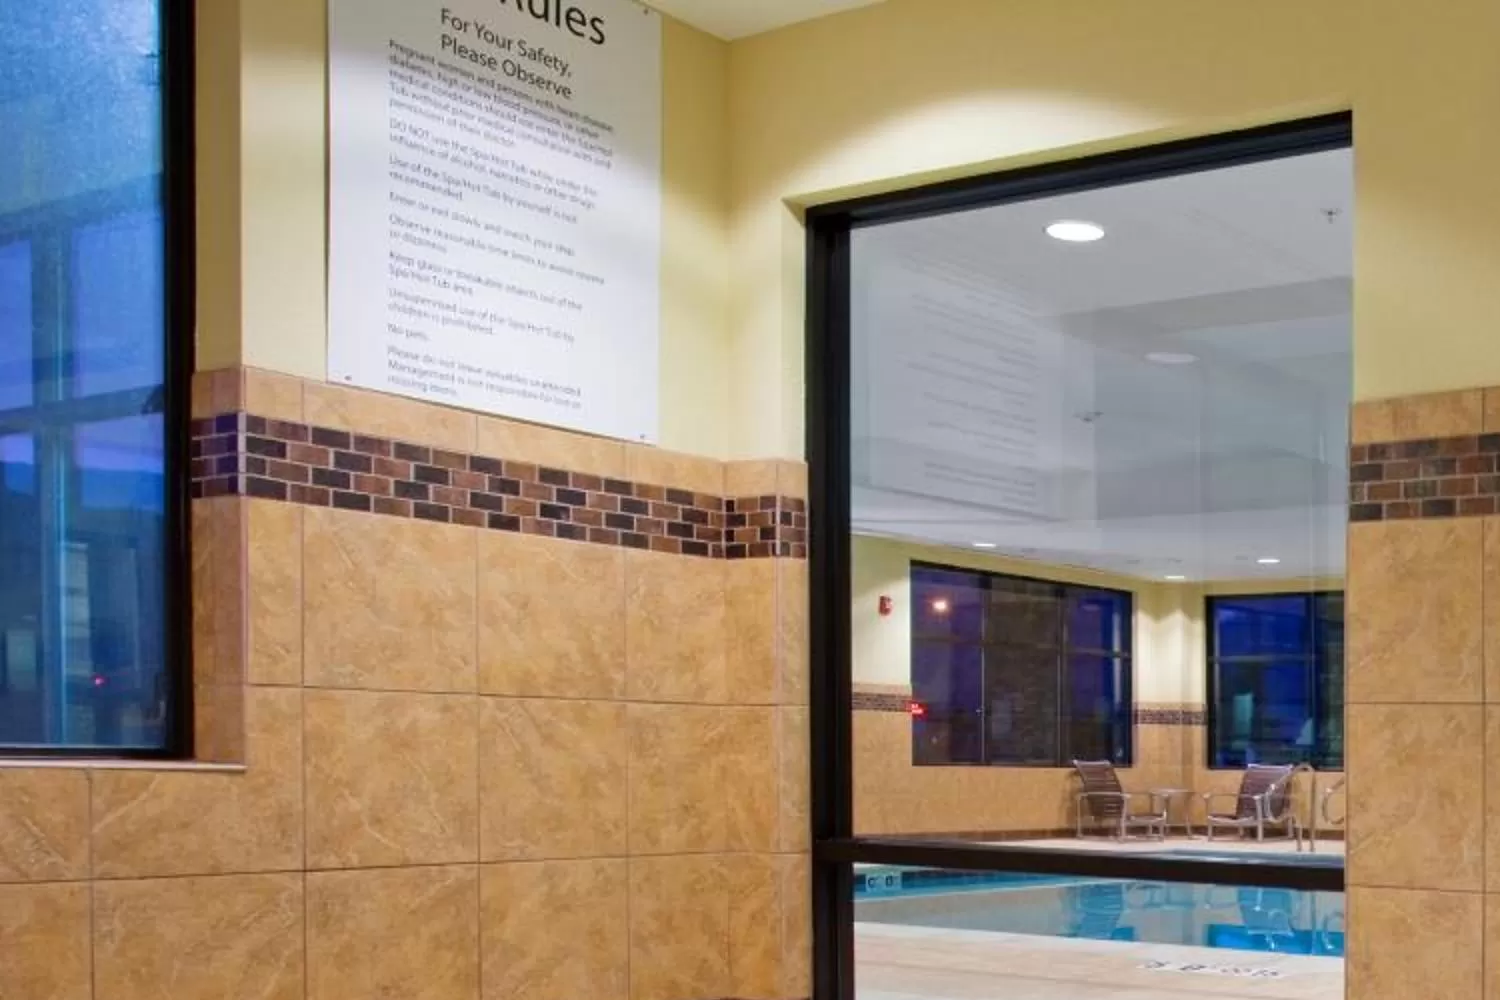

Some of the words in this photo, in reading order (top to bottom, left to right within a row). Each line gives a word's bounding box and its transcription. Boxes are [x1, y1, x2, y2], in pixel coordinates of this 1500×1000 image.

[441, 8, 471, 32] For
[473, 22, 513, 51] Your
[517, 39, 572, 77] Safety,
[500, 0, 605, 45] ules
[441, 34, 498, 71] Please
[502, 59, 572, 100] Observe
